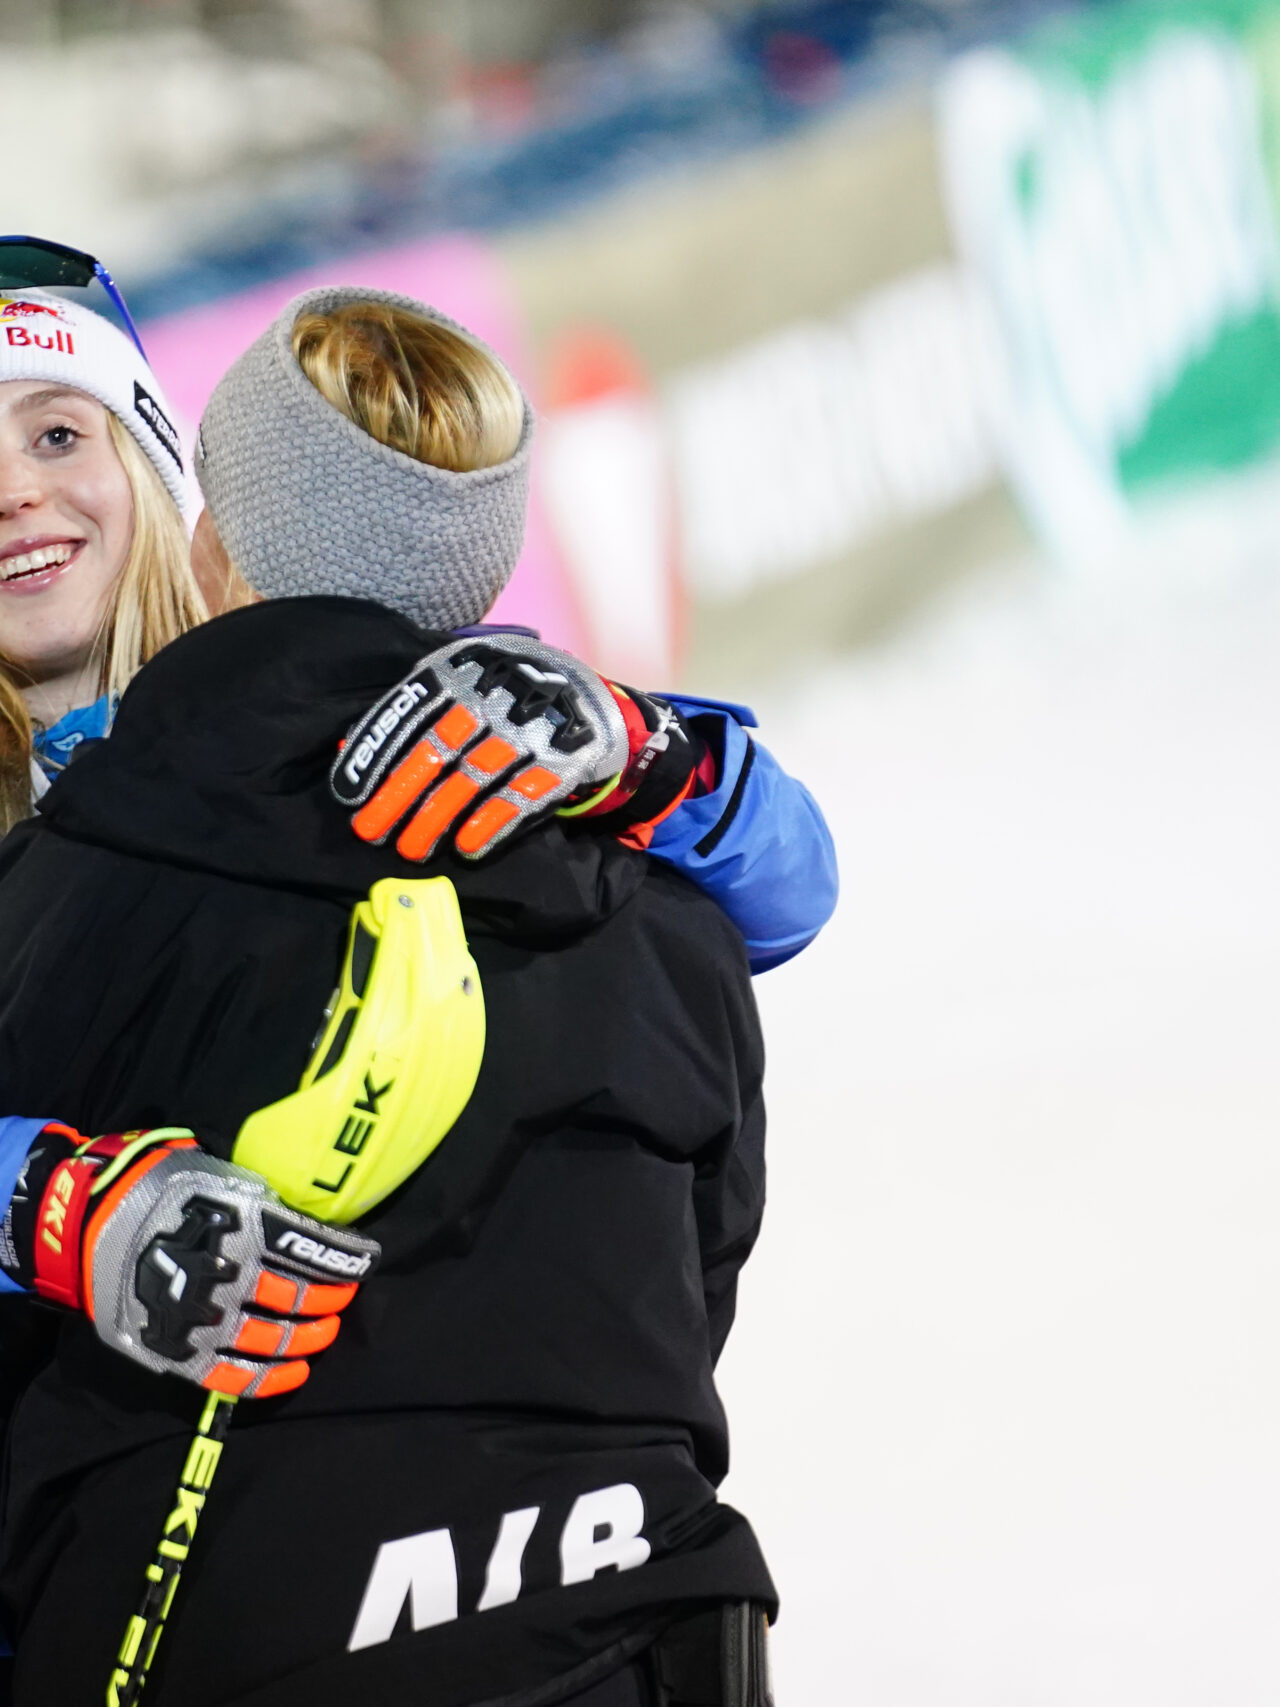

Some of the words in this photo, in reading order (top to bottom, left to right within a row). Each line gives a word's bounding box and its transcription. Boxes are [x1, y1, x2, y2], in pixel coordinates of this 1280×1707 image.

[6, 327, 75, 355] Bull
[344, 680, 429, 784] reusch
[42, 1165, 76, 1254] EKI
[276, 1229, 372, 1276] reusch
